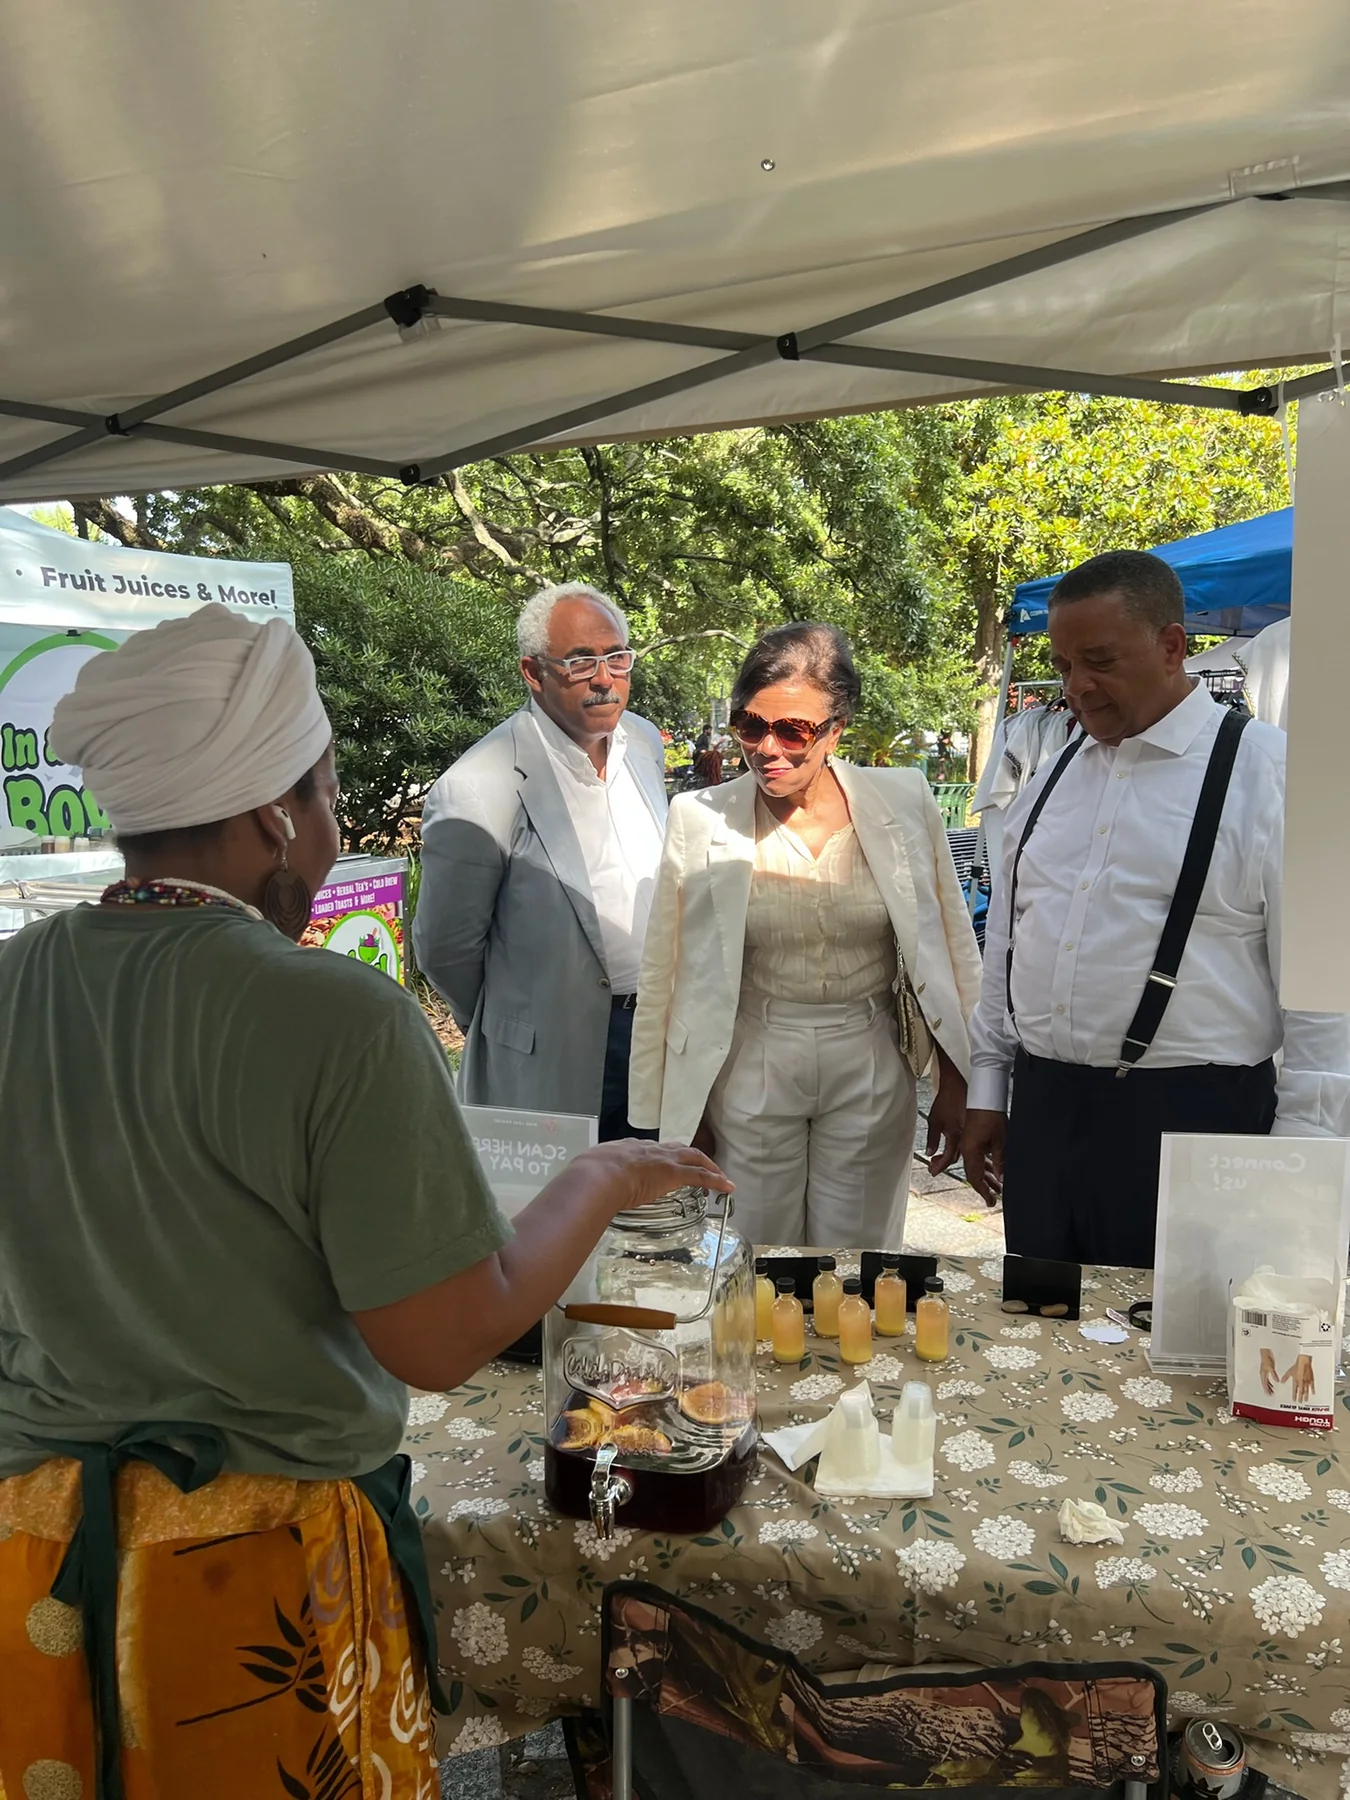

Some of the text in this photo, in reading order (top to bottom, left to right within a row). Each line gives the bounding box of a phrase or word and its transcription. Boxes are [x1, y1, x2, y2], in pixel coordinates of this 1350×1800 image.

[40, 566, 278, 610] Fruit Juices & More!
[1, 722, 40, 772] In
